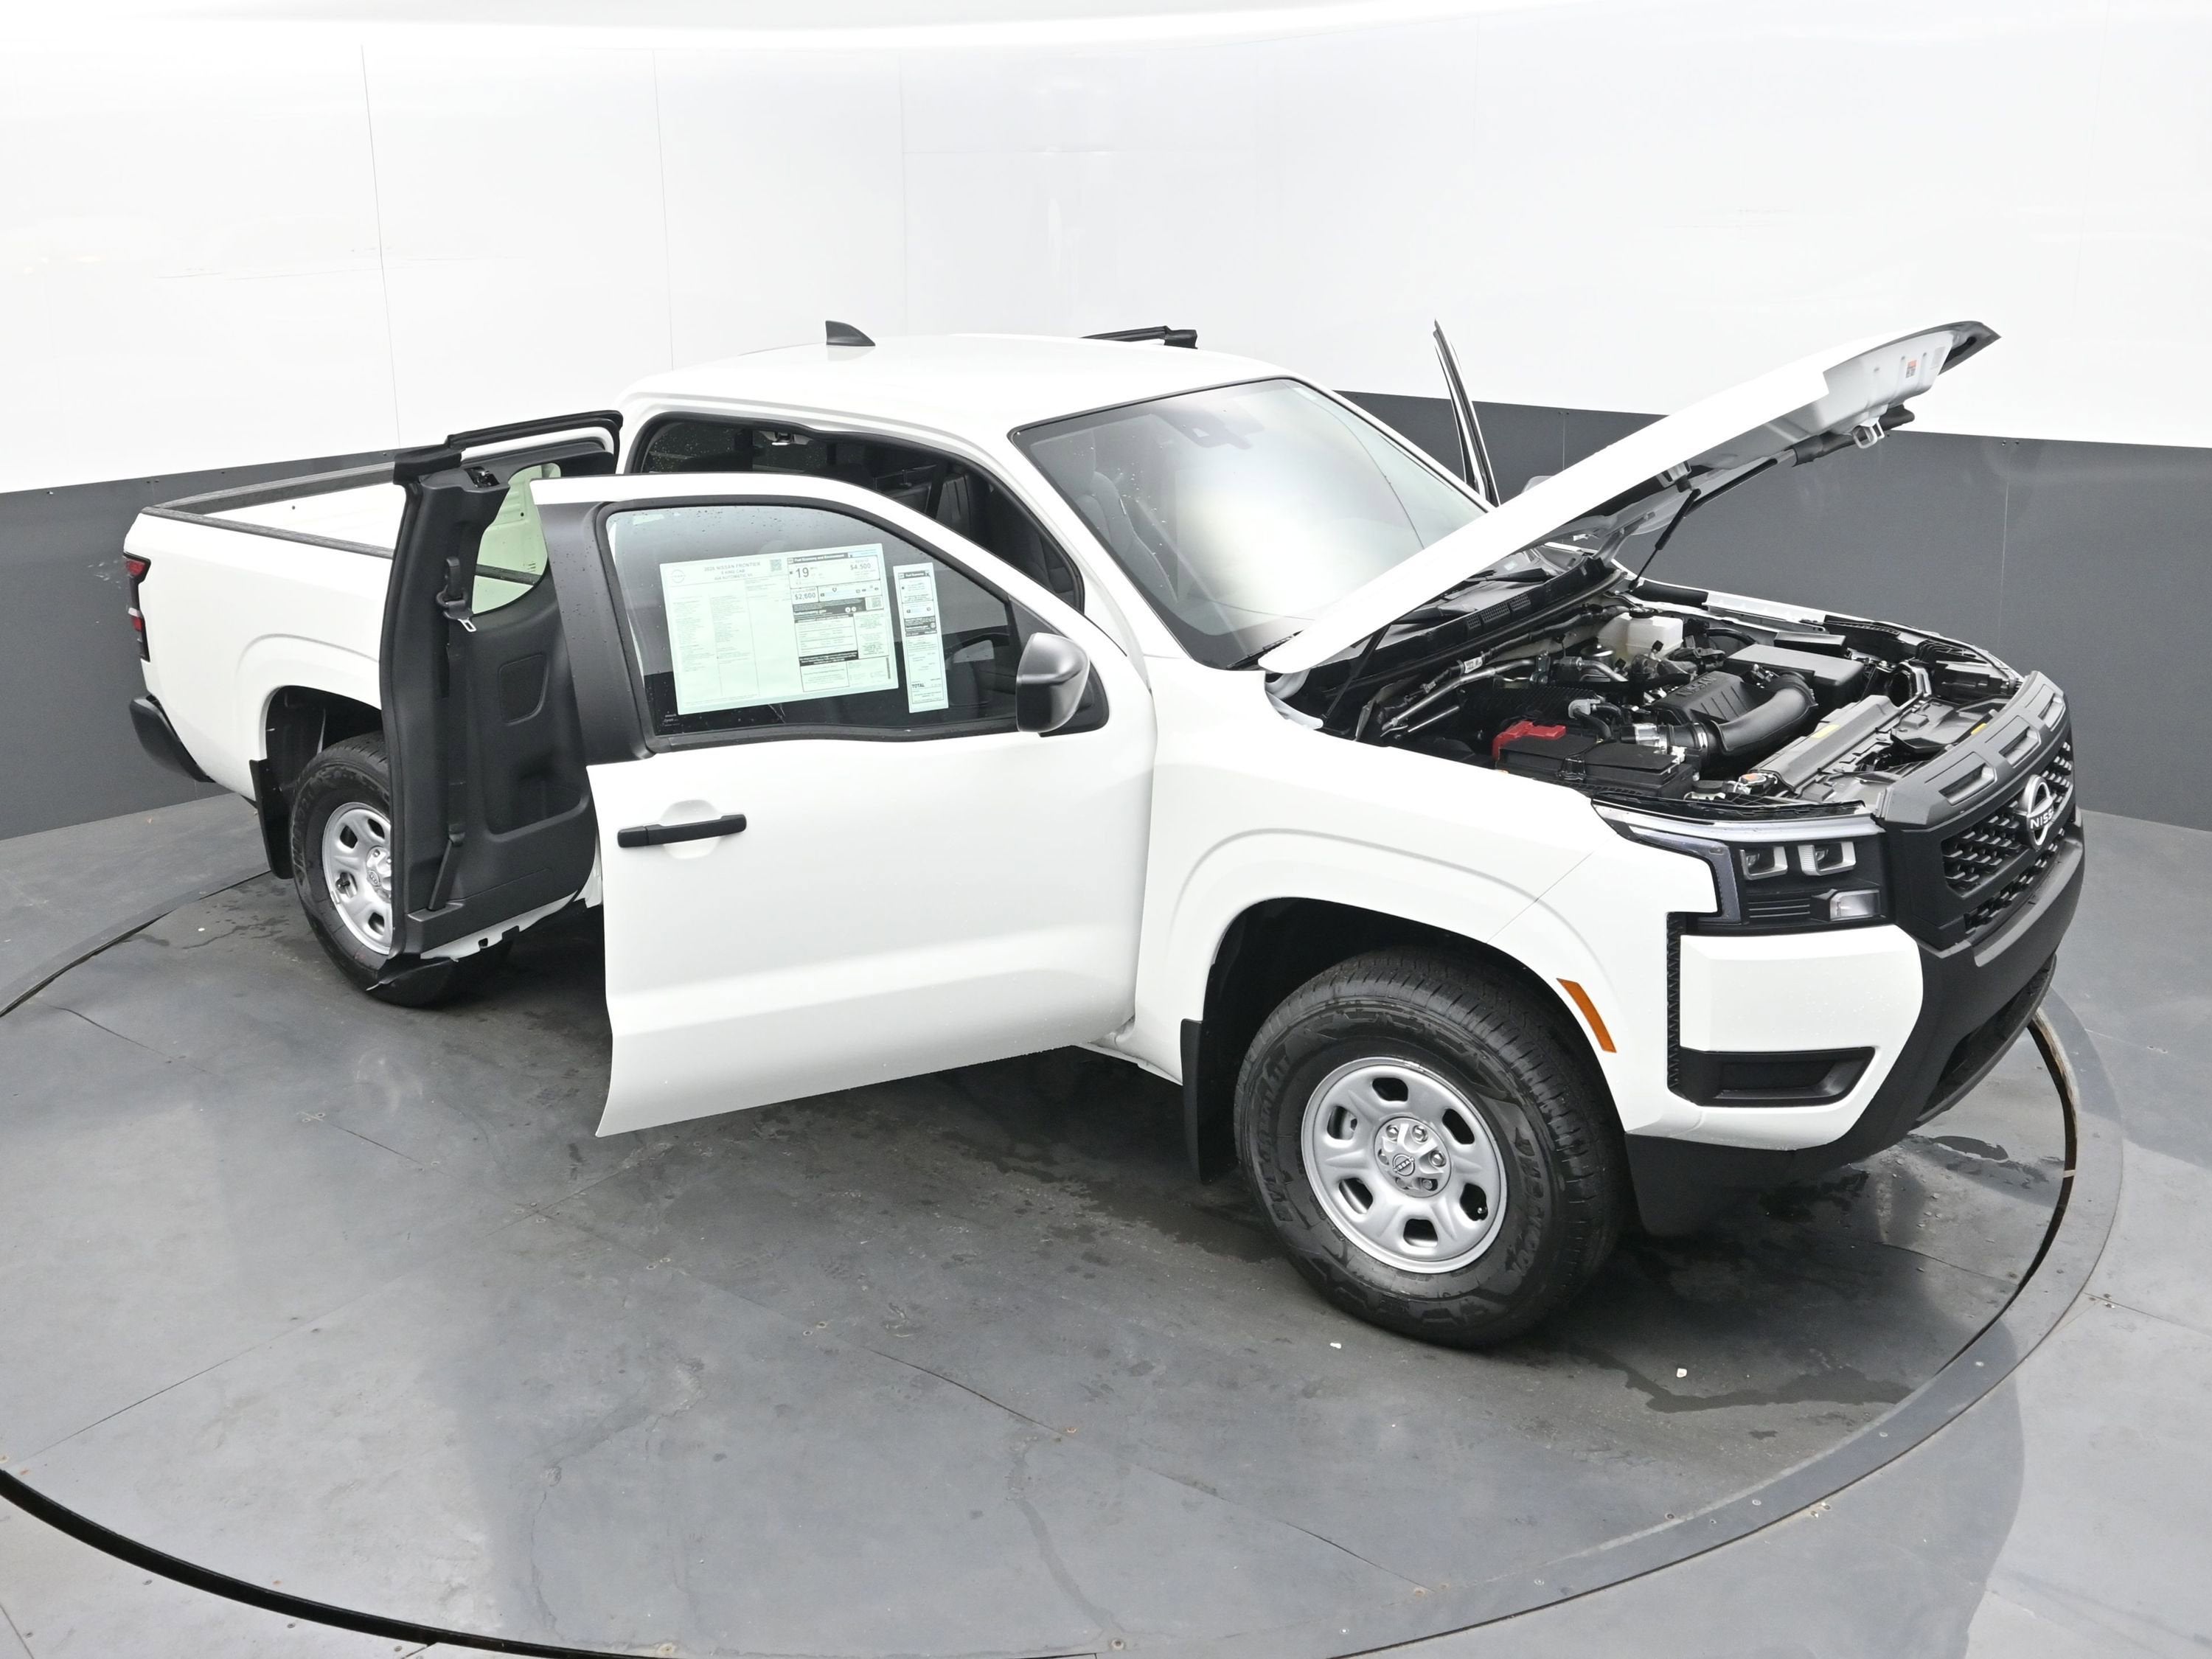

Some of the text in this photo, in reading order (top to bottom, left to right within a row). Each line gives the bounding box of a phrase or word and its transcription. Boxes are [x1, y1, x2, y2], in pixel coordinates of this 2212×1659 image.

[796, 567, 810, 578] 19
[795, 592, 815, 600] $2,600
[1674, 676, 1717, 697] NISSAN
[2030, 808, 2054, 830] NISS
